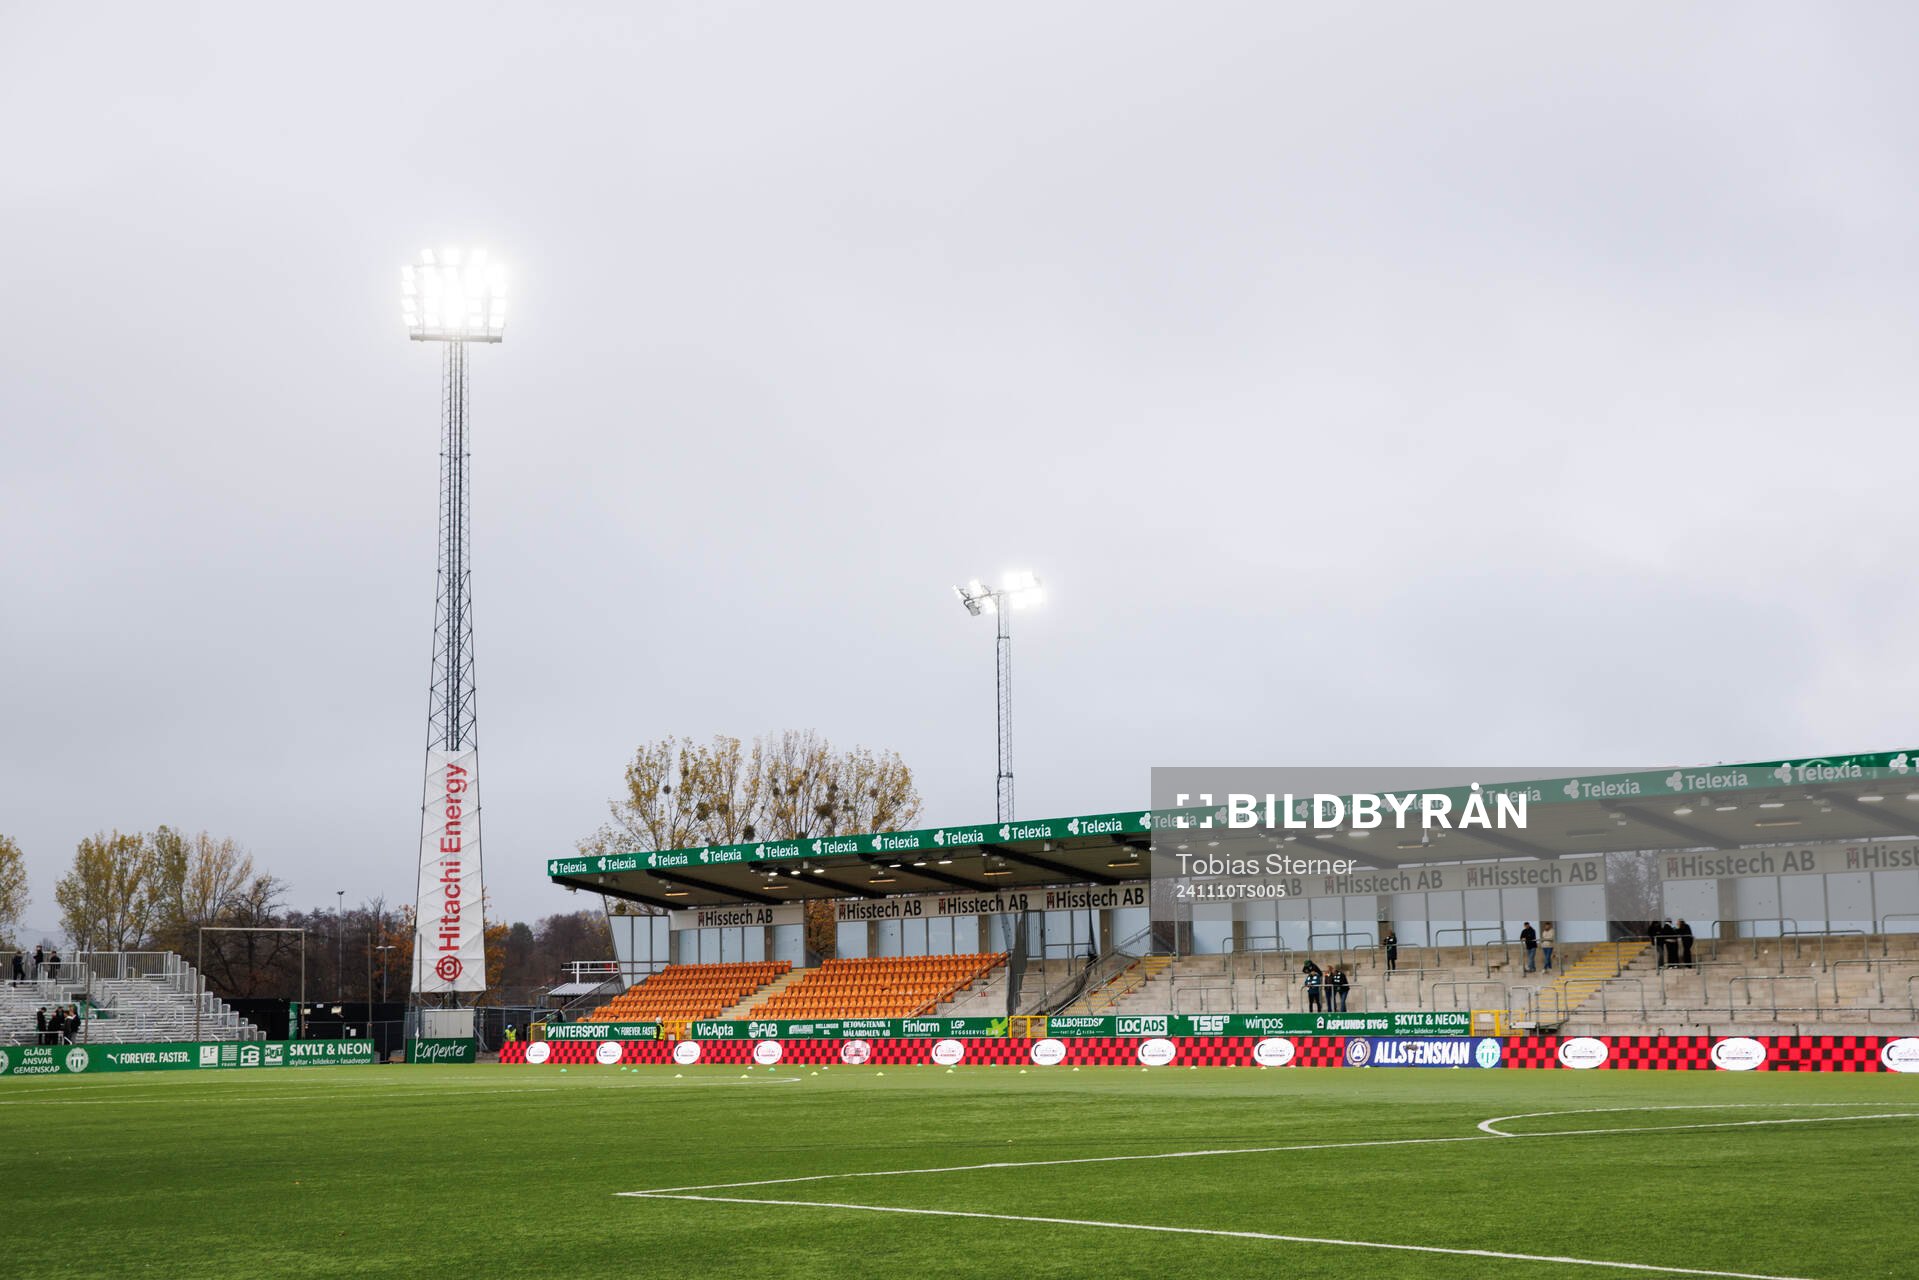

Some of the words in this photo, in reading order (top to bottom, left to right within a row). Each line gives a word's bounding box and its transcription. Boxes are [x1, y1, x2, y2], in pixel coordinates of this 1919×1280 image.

[1796, 759, 1862, 782] Telexia
[1686, 771, 1748, 790] Telexia
[1582, 778, 1640, 798] Telexia
[440, 764, 467, 853] Energy
[1012, 824, 1052, 840] Telexia
[1081, 818, 1122, 834] Telexia
[883, 835, 919, 849] Telexia
[946, 830, 984, 845] Telexia
[766, 844, 799, 857] Telexia
[823, 840, 858, 854] Telexia
[658, 853, 688, 866] Telexia
[710, 849, 742, 862] Telexia
[559, 861, 587, 873] Telexia
[607, 857, 636, 871] Telexia
[1682, 851, 1774, 876] Hisstech
[1783, 850, 1815, 872] AB
[1480, 862, 1562, 887] Hisstech
[1569, 861, 1598, 883] AB
[1337, 871, 1410, 894] Hisstech
[1417, 870, 1443, 890] AB
[948, 894, 1004, 914] Hisstech
[1008, 893, 1028, 911] AB
[1056, 889, 1118, 909] Hisstech
[1123, 887, 1144, 905] AB
[439, 861, 461, 951] Hitachi
[847, 900, 899, 919] Hisstech
[903, 899, 922, 916] AB
[705, 910, 753, 926] Hisstech
[756, 909, 773, 924] AB
[903, 1020, 940, 1033] Finlarm
[951, 1020, 965, 1029] LGP
[1051, 1018, 1099, 1028] SALBOHEDS
[1245, 1015, 1283, 1035] winpos
[1367, 1018, 1389, 1029] BYGG
[1395, 1014, 1423, 1025] SKYLT
[1425, 1014, 1434, 1025] &
[1435, 1014, 1465, 1025] NEON
[556, 1025, 609, 1038] INTERSPORT
[697, 1023, 734, 1038] VicApta
[758, 1023, 778, 1037] FVB
[289, 1044, 325, 1056] SKYLT
[327, 1043, 335, 1055] &
[342, 1043, 372, 1055] NEON
[416, 1041, 467, 1063] Carpenter
[1374, 1041, 1470, 1064] ALLSVENSKAN
[22, 1057, 53, 1065] ANSVAR
[120, 1052, 158, 1064] FOREVER.
[159, 1052, 191, 1063] FASTER.
[289, 1059, 308, 1067] skyltar
[312, 1058, 336, 1066] bildekor
[13, 1065, 60, 1074] GEMENSKAP
